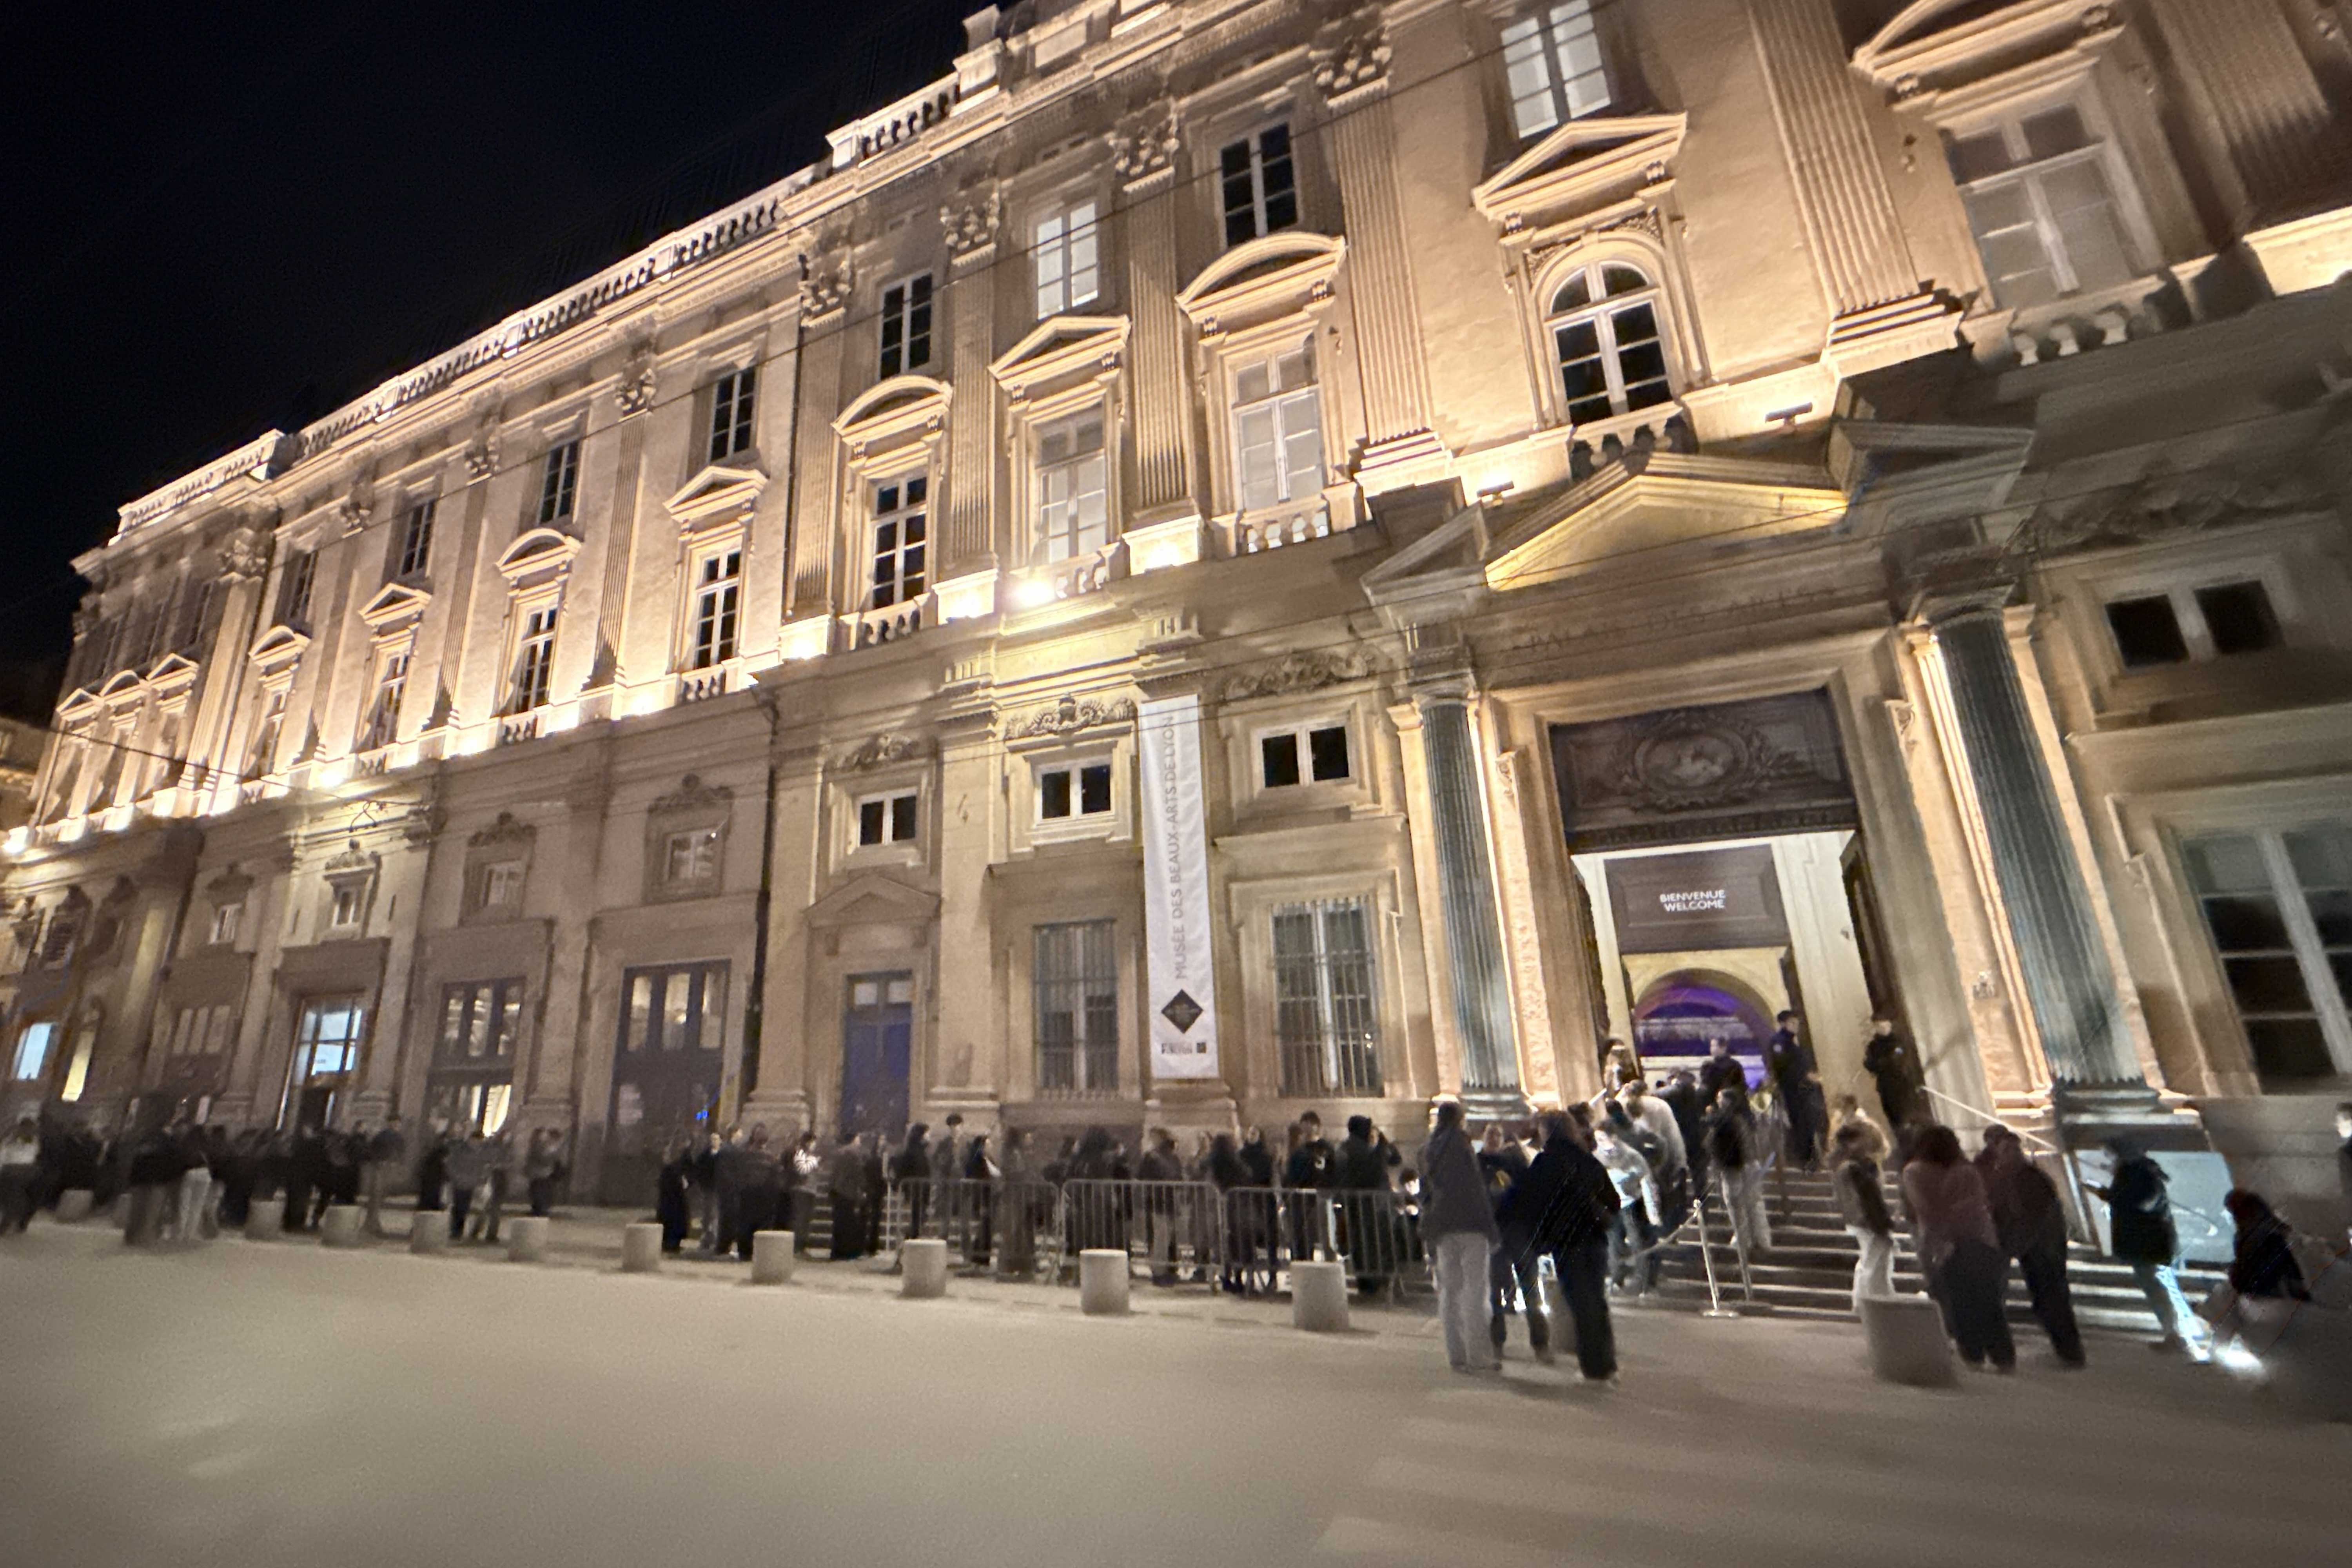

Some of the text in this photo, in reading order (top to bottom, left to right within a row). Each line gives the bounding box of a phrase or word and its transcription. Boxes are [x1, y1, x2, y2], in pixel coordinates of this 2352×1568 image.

[1162, 716, 1187, 980] MUSÉE DES BEAUX-ARTS DE LYON
[1659, 889, 1726, 903] BIENVENUE
[1664, 900, 1725, 912] WELCOME
